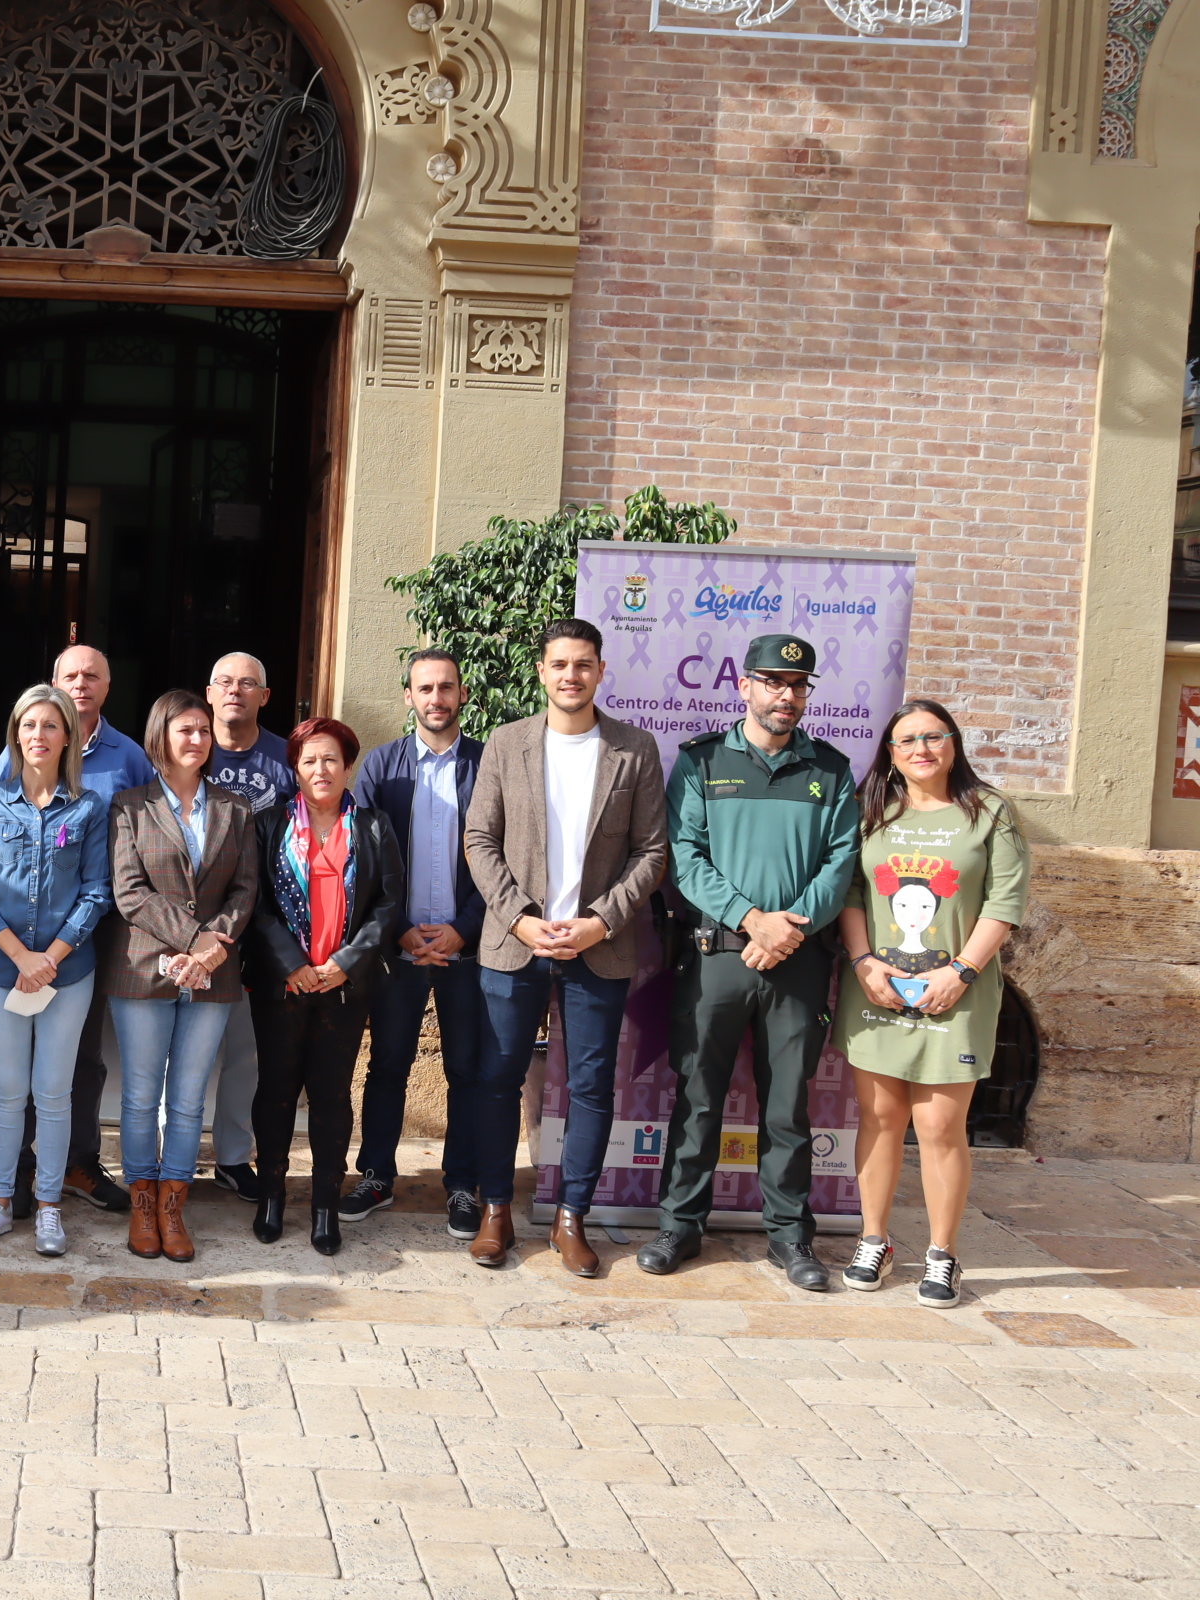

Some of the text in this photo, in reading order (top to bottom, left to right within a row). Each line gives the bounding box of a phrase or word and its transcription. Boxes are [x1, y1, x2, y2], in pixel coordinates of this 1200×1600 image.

[805, 599, 876, 616] Igualdad
[610, 614, 658, 624] Ayuntamiento
[614, 623, 653, 633] de Águilas
[677, 654, 740, 691] CA
[605, 694, 870, 719] Centro de Atenció cializada
[639, 716, 702, 734] Mujeres
[800, 722, 873, 739] Violencia
[822, 1161, 848, 1169] Estado
